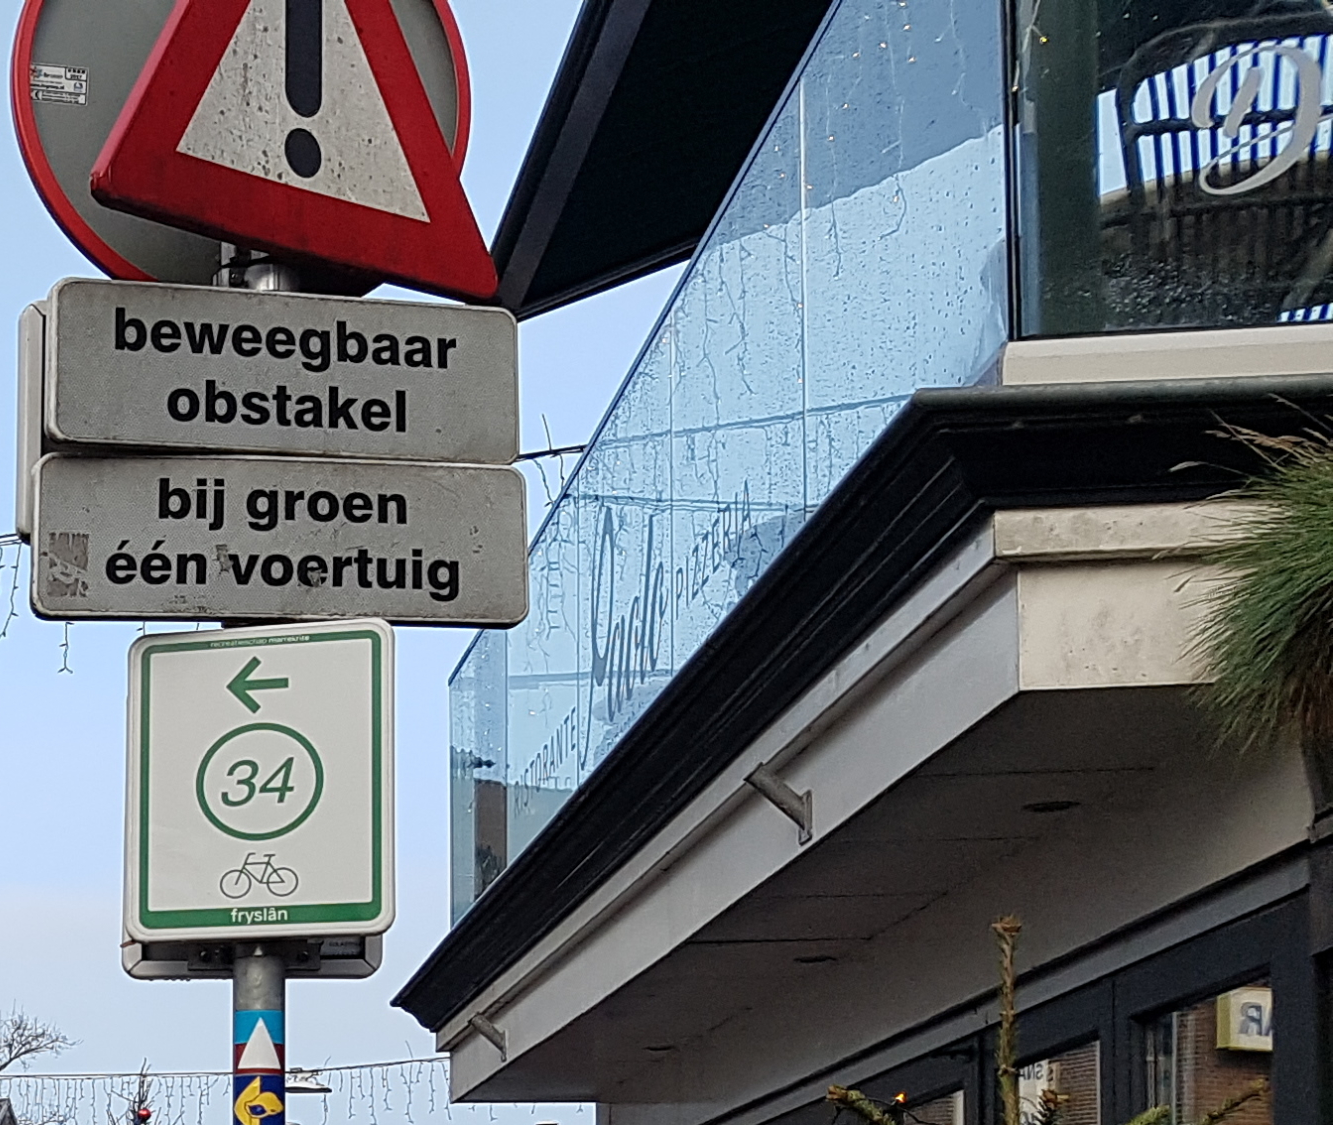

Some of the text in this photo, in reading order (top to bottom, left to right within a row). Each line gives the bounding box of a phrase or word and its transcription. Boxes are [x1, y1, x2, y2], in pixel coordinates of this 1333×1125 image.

[114, 307, 456, 372] beweegbaar
[167, 380, 407, 432] obstakel
[157, 478, 408, 532] bij groen
[105, 541, 460, 600] één voertuig
[220, 756, 295, 807] 34
[229, 906, 288, 926] fryslân
